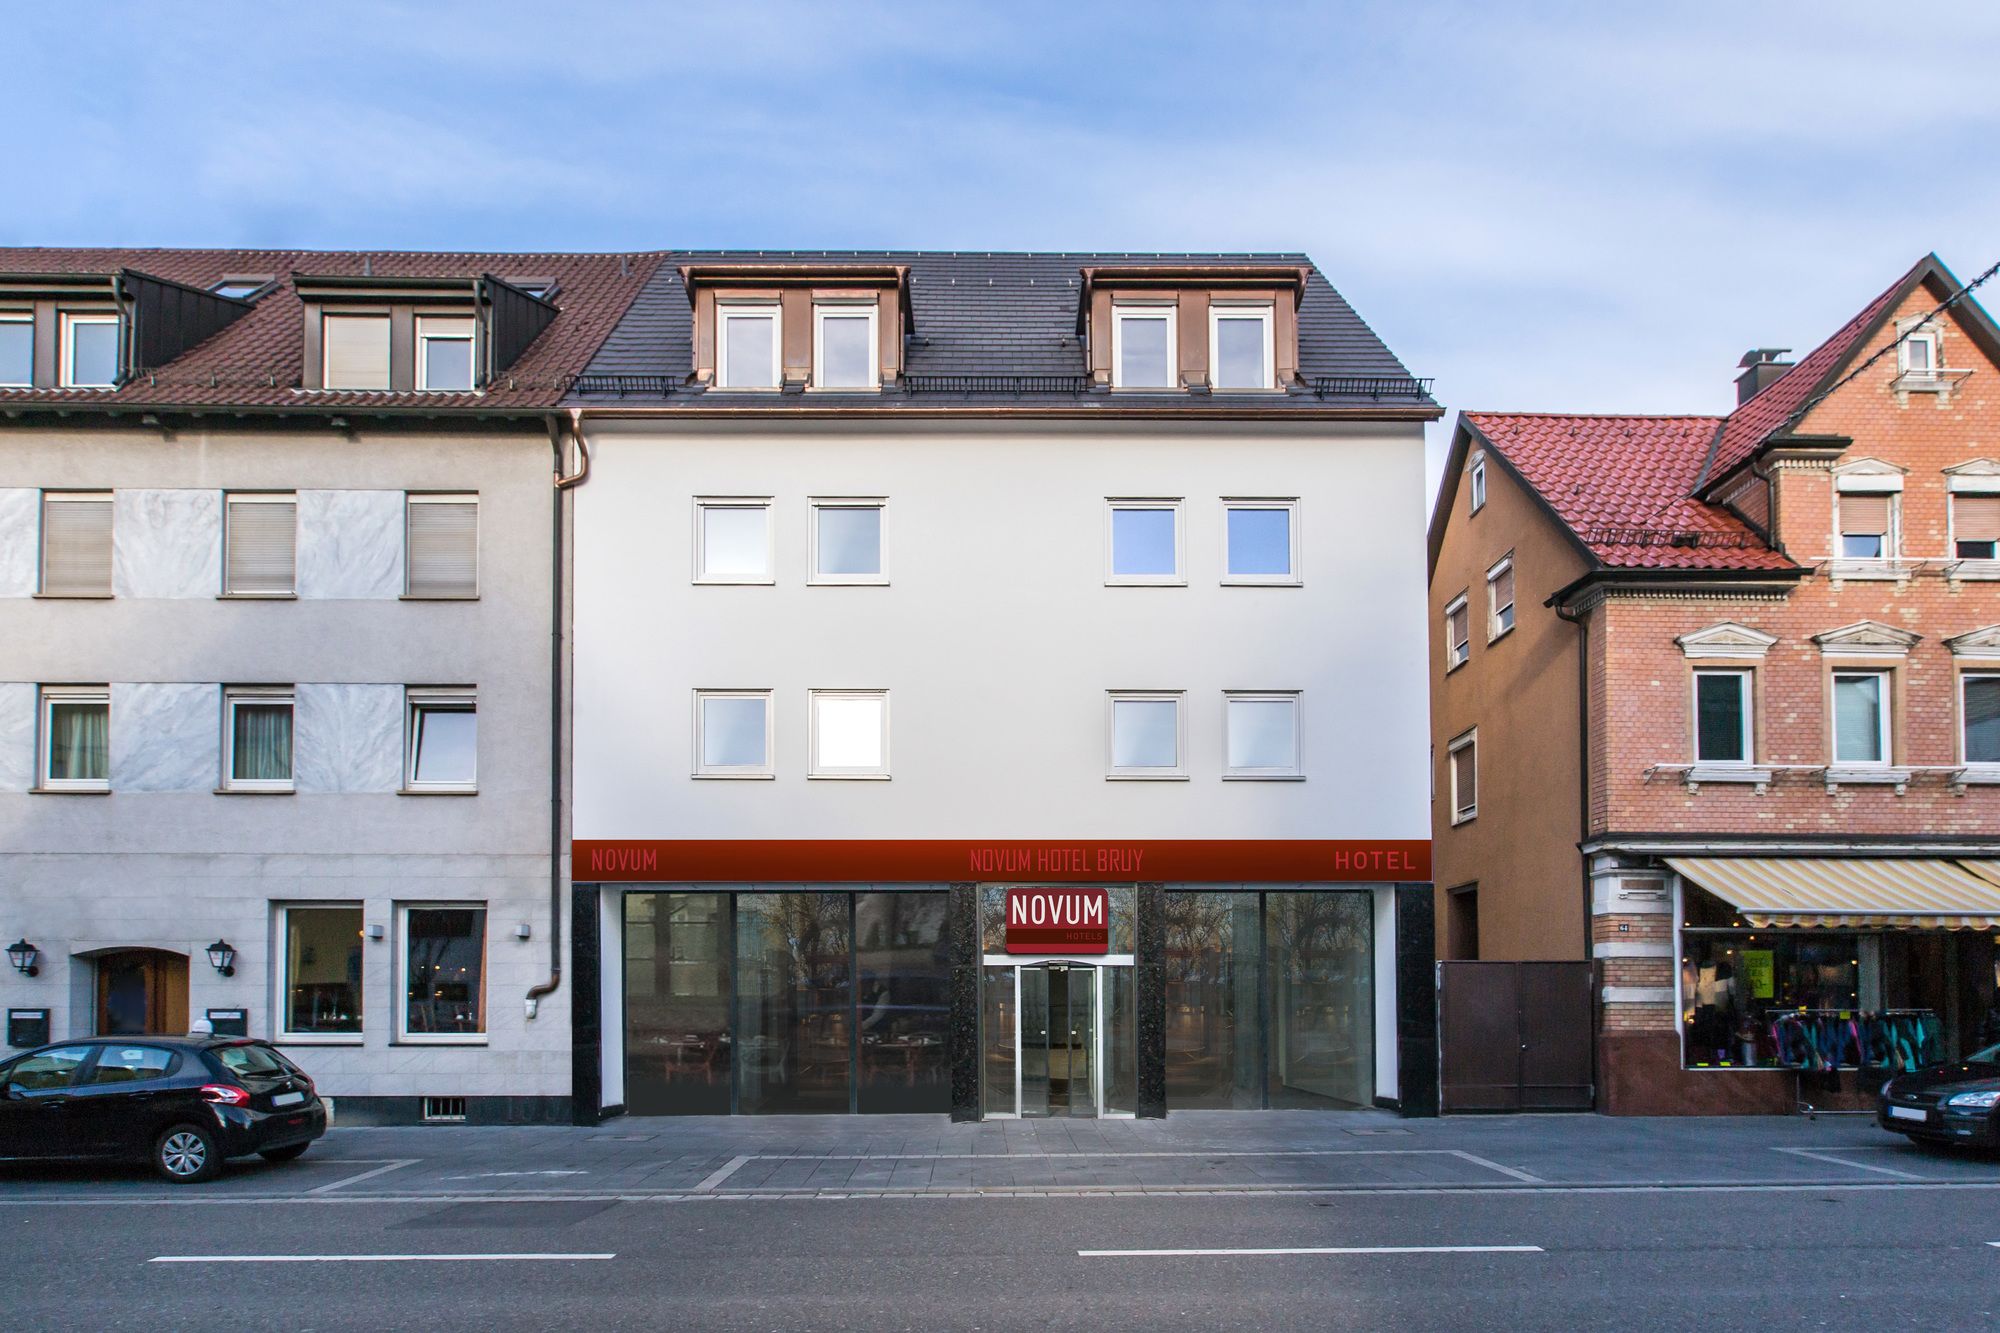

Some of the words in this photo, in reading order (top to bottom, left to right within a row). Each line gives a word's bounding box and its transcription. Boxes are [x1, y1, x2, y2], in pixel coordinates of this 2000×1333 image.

[591, 849, 657, 871] NOVUM
[970, 849, 1031, 872] NOVUM
[1038, 849, 1091, 872] HOTEL
[1097, 849, 1143, 872] BRUY
[1335, 851, 1416, 870] HOTEL
[1012, 895, 1103, 925] NOVUM
[1066, 932, 1103, 941] HOTELS
